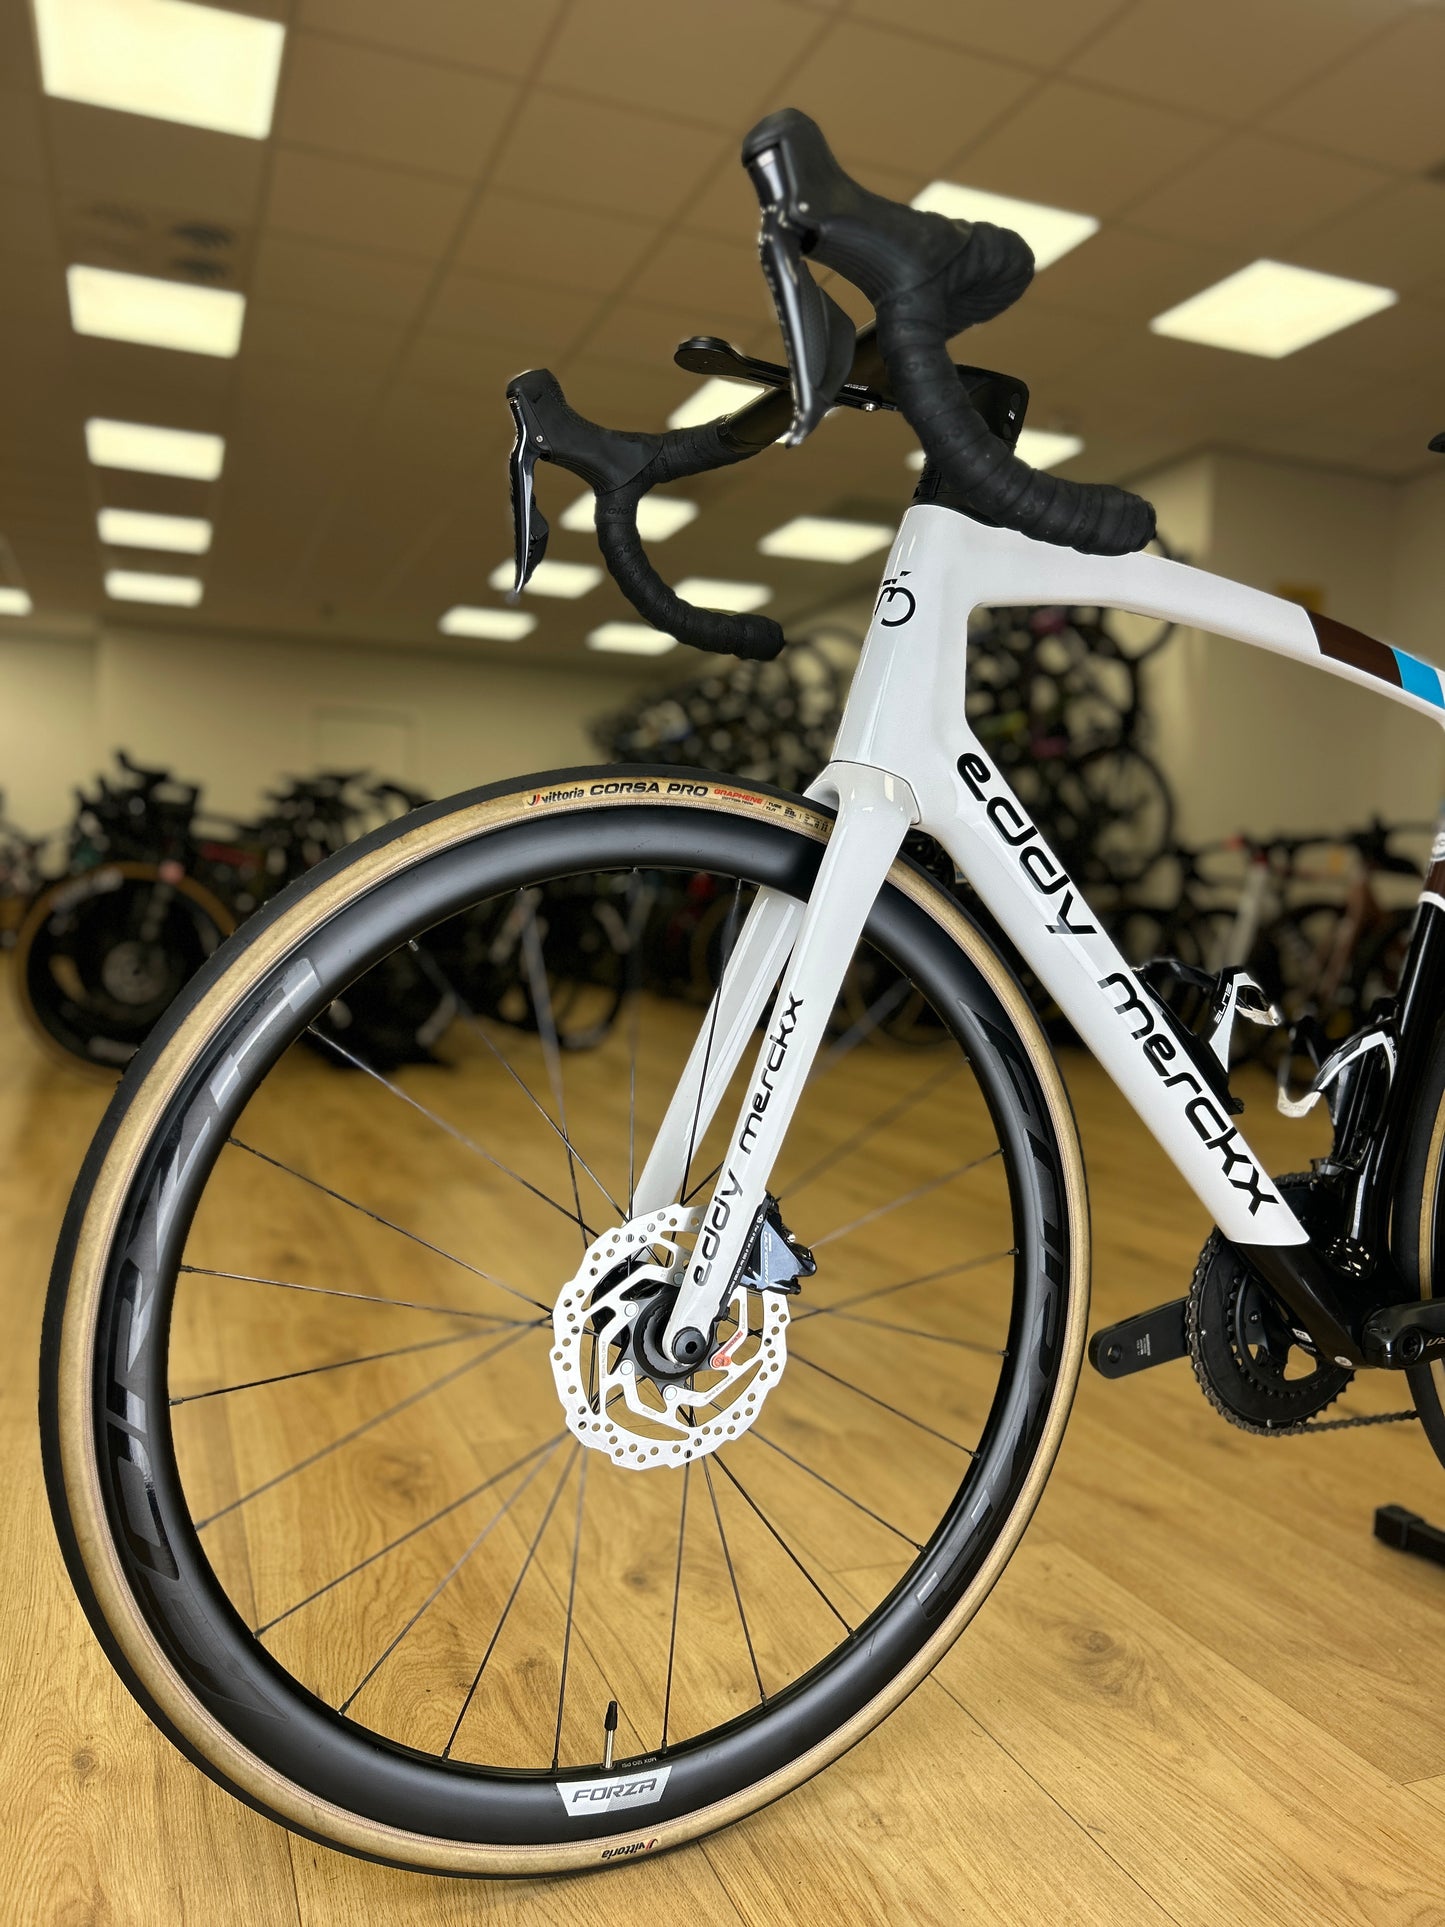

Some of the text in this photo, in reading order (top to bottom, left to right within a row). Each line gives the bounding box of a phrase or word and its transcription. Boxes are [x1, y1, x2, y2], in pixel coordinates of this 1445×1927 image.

[541, 787, 585, 804] vittoria
[589, 782, 660, 796] CORSA
[666, 783, 709, 797] PRO
[713, 788, 764, 805] GRAPHENE
[956, 752, 1280, 1217] eddy merckx
[692, 1167, 744, 1287] eddy
[738, 990, 804, 1155] merckx
[571, 1778, 657, 1803] FORZA
[601, 1842, 645, 1860] vittoria
